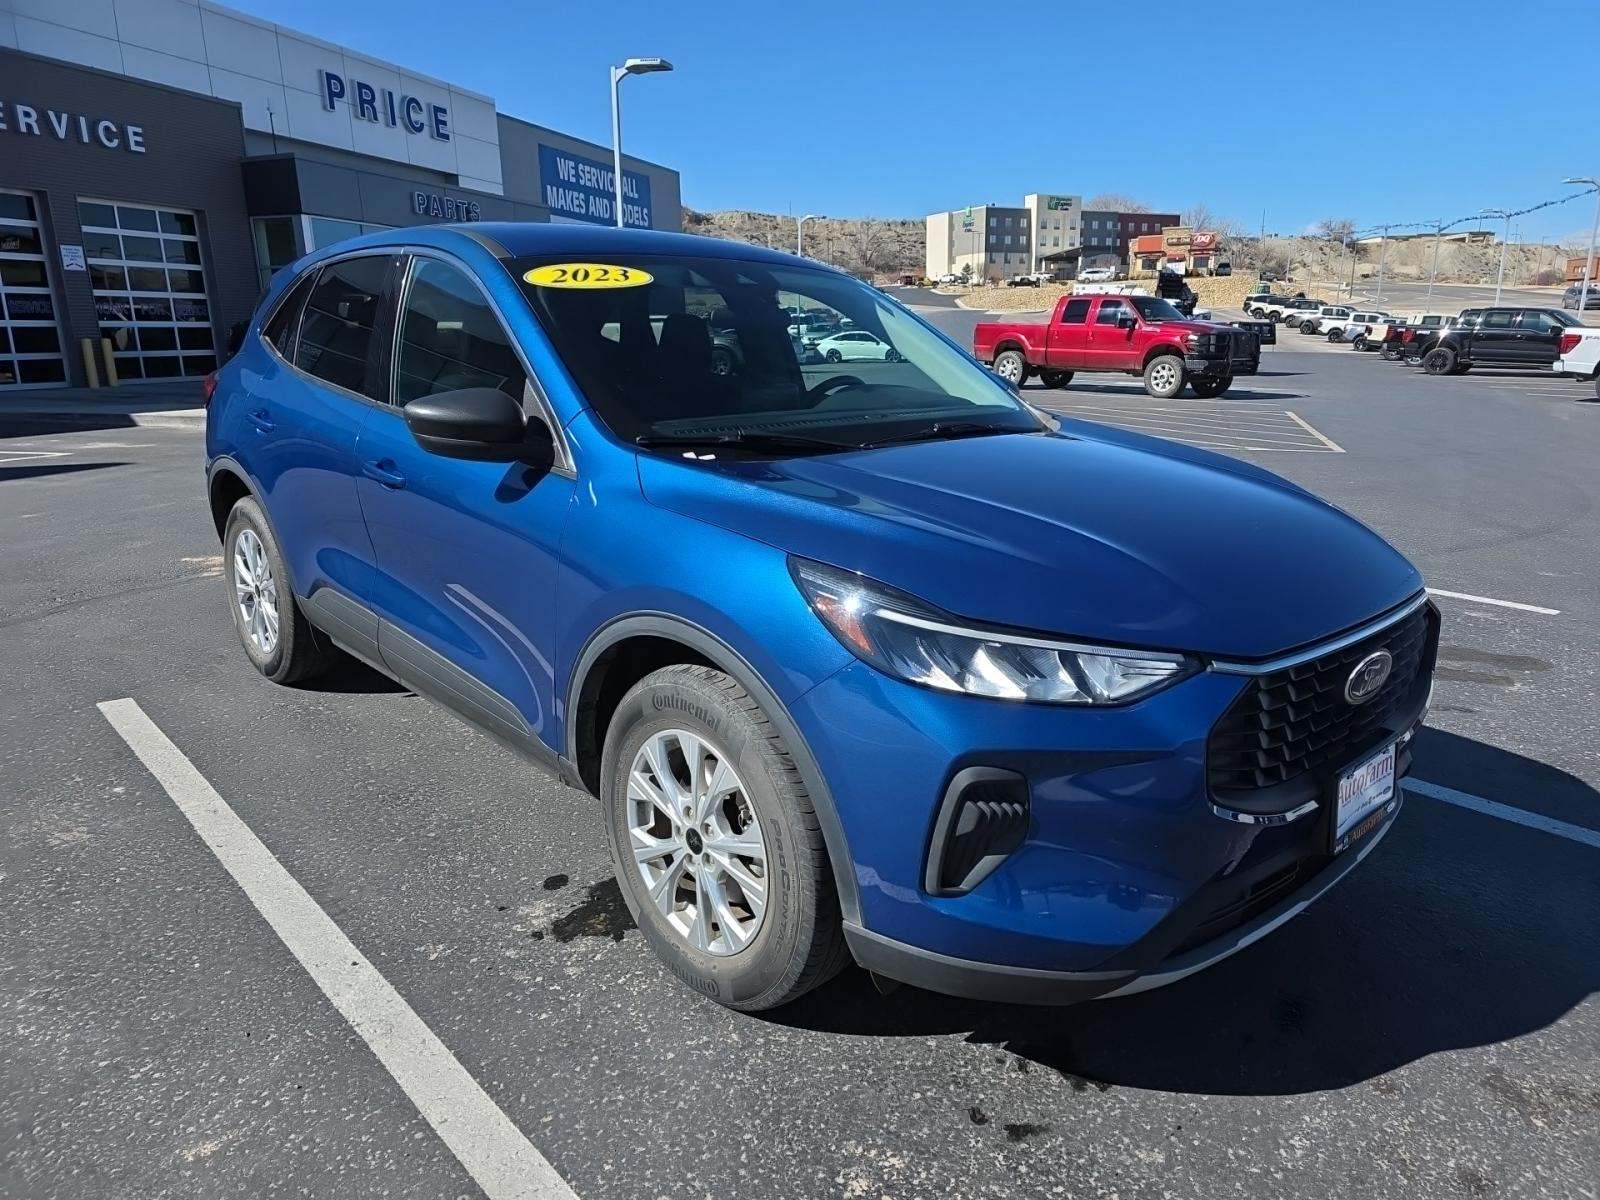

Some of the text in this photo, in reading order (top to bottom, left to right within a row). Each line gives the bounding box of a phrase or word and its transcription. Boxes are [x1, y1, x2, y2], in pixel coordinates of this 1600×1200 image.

[321, 71, 450, 142] PRICE
[557, 157, 639, 199] WE SERVIC ALL
[414, 191, 481, 222] PARTS
[546, 184, 586, 214] MAKES
[589, 195, 610, 219] AND
[551, 268, 630, 283] 2023
[652, 692, 722, 732] Continental
